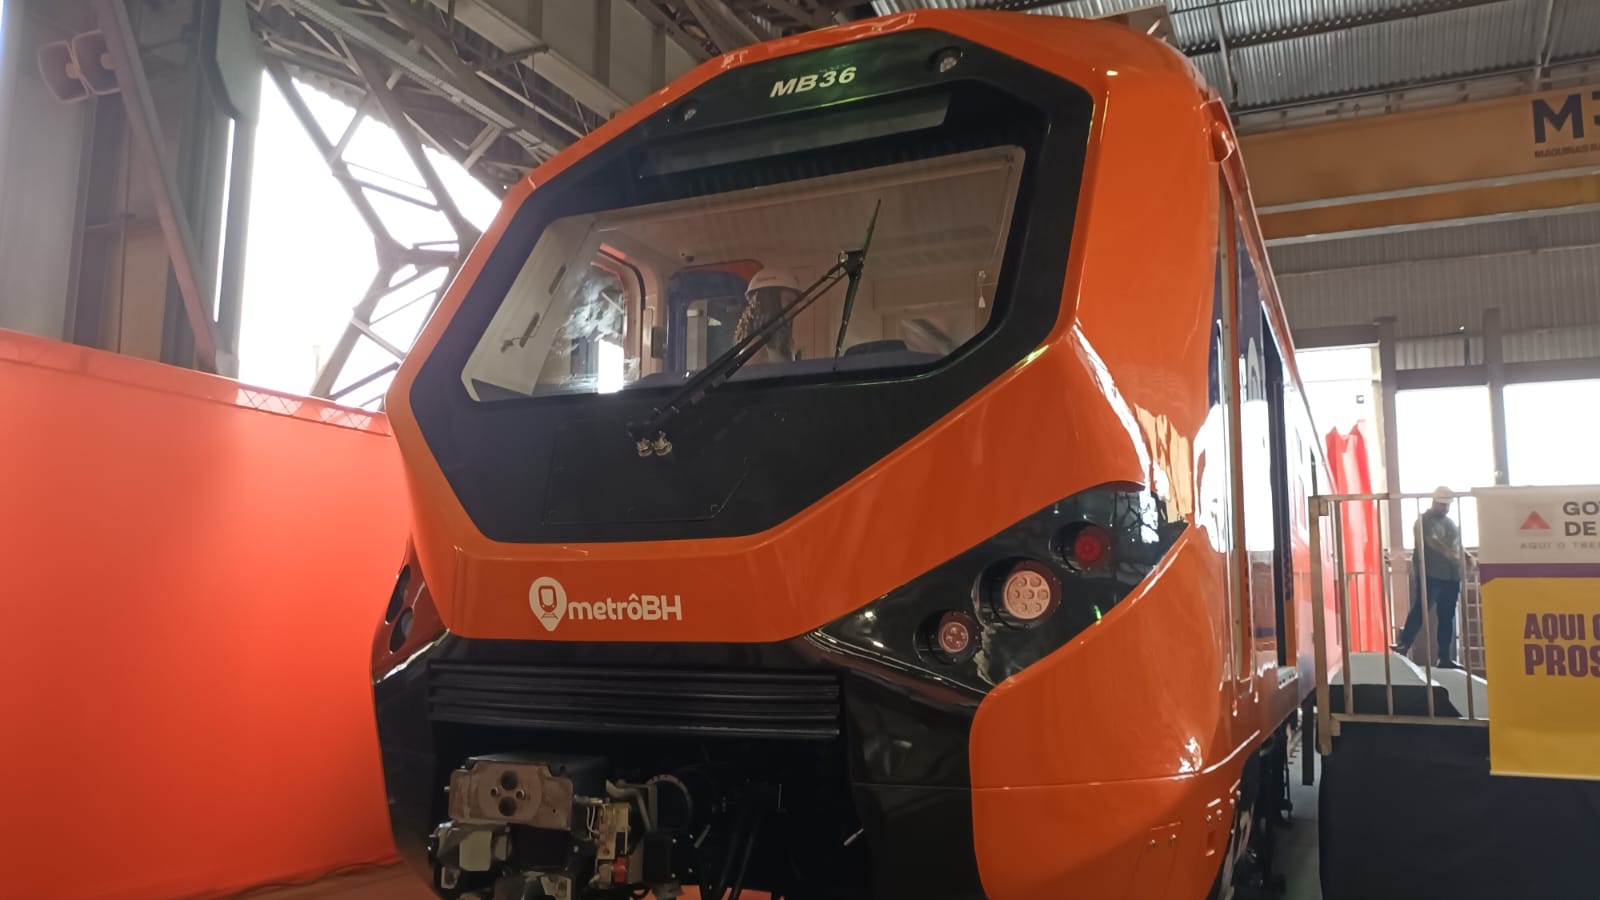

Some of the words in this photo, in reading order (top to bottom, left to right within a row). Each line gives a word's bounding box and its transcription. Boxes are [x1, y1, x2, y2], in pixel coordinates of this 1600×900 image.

[769, 66, 857, 98] MB36
[1563, 501, 1600, 516] GO
[1564, 521, 1597, 536] DE
[1572, 541, 1600, 550] TRE
[568, 593, 682, 621] metrôBH
[1524, 613, 1586, 643] AQUI
